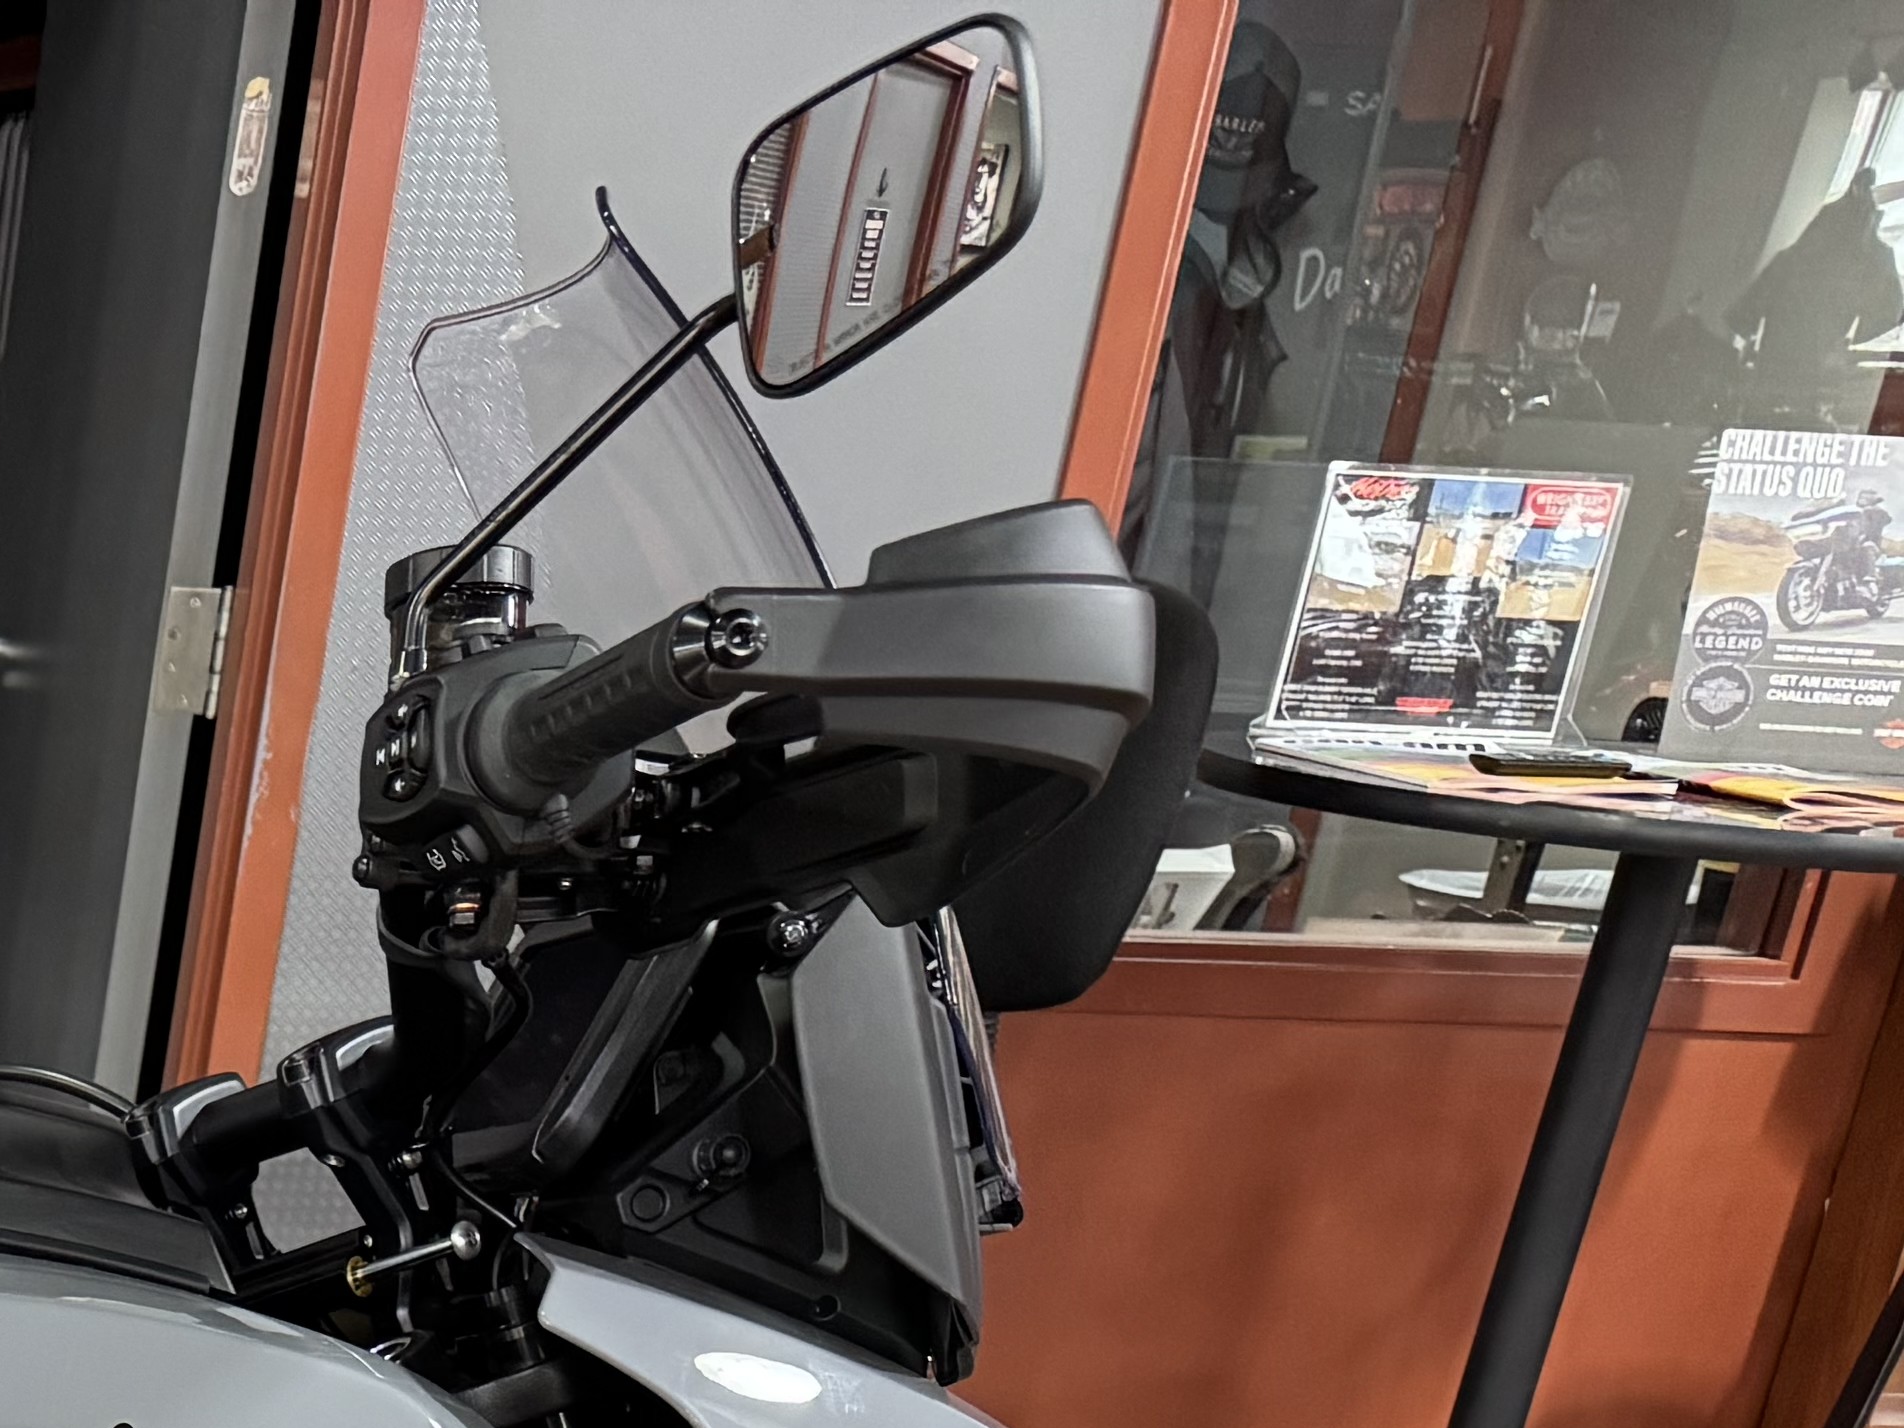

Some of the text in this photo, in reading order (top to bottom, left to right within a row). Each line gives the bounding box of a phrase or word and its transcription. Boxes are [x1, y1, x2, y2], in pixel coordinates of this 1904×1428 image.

[1719, 431, 1891, 467] CHALLENGE THE
[1713, 463, 1796, 496] STATUS
[1694, 634, 1763, 651] LEGEND
[1768, 673, 1902, 693] GET AN EXCLUSIVE
[1766, 688, 1853, 705] CHALLENGE
